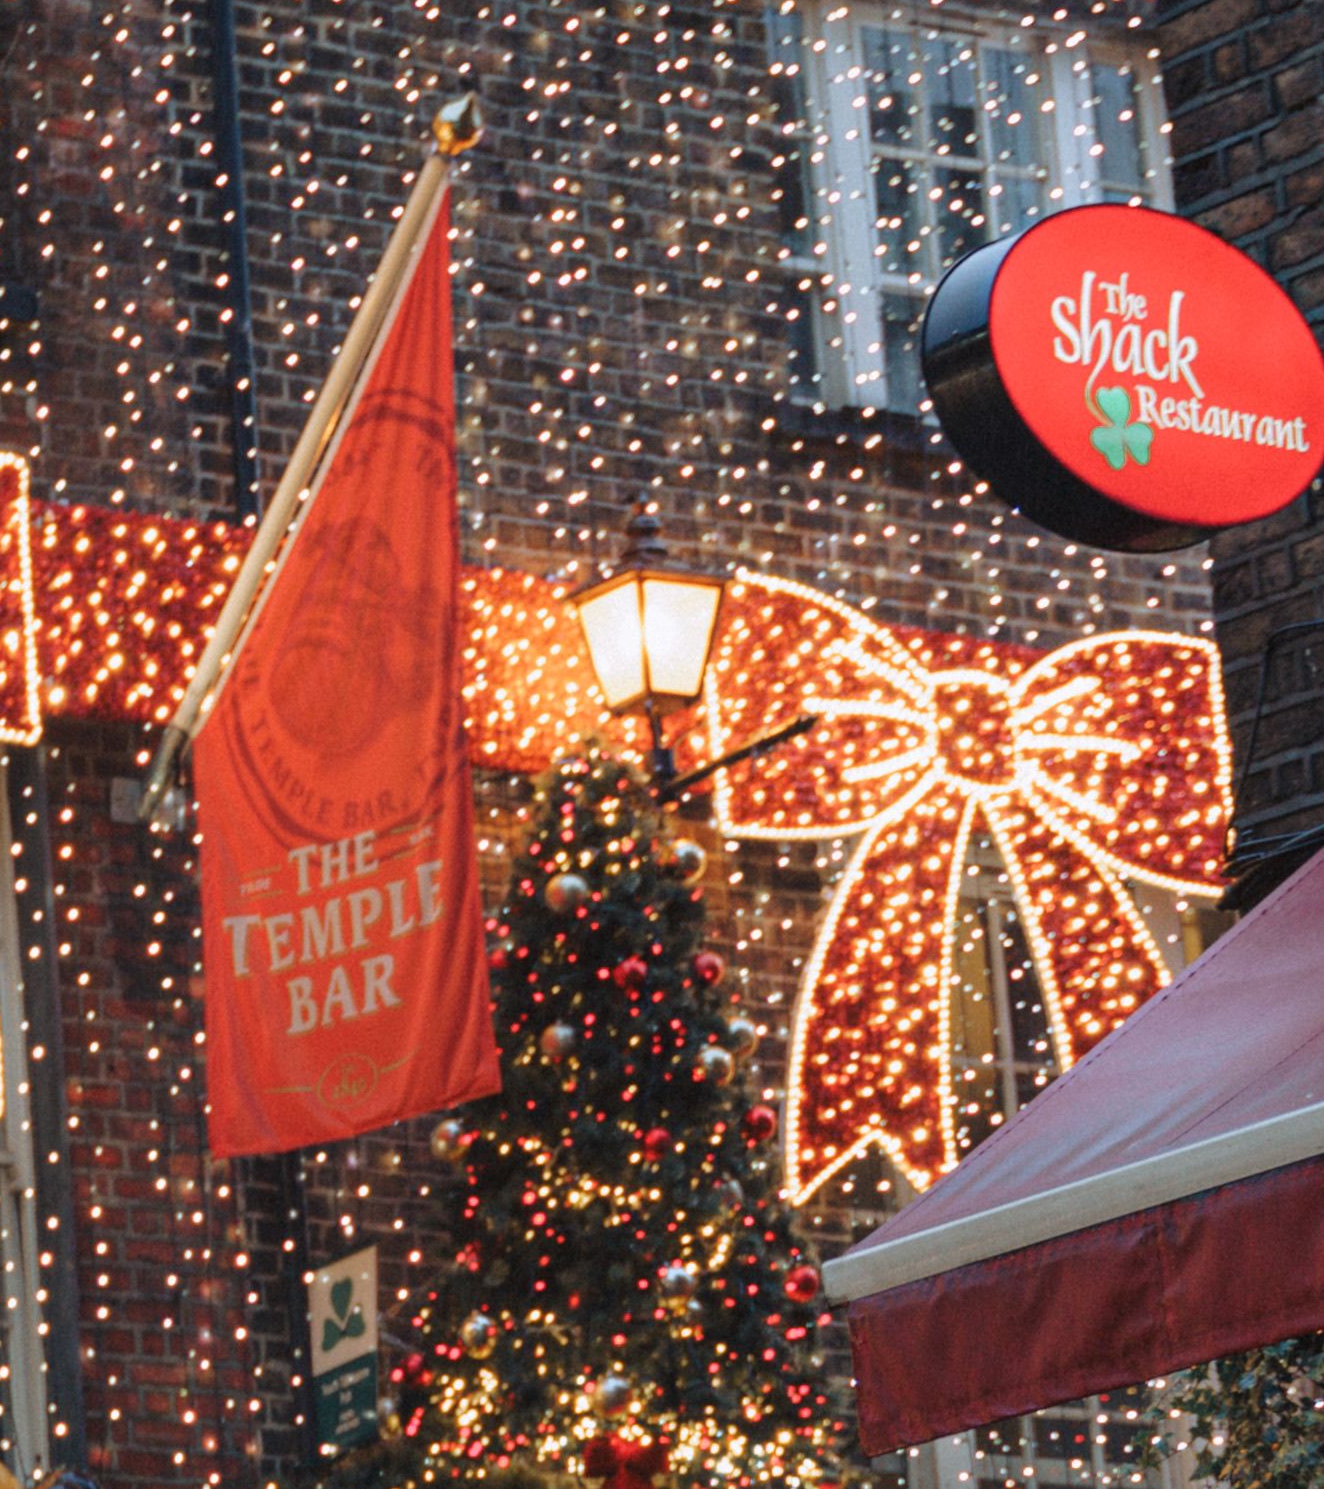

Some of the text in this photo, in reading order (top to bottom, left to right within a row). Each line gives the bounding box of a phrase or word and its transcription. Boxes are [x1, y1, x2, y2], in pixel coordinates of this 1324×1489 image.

[1051, 271, 1204, 398] Shack
[1098, 273, 1148, 322] The
[1135, 385, 1309, 453] Restaurant
[288, 829, 380, 897] THE
[222, 860, 445, 978] TEMPLE
[286, 954, 401, 1037] BAR
